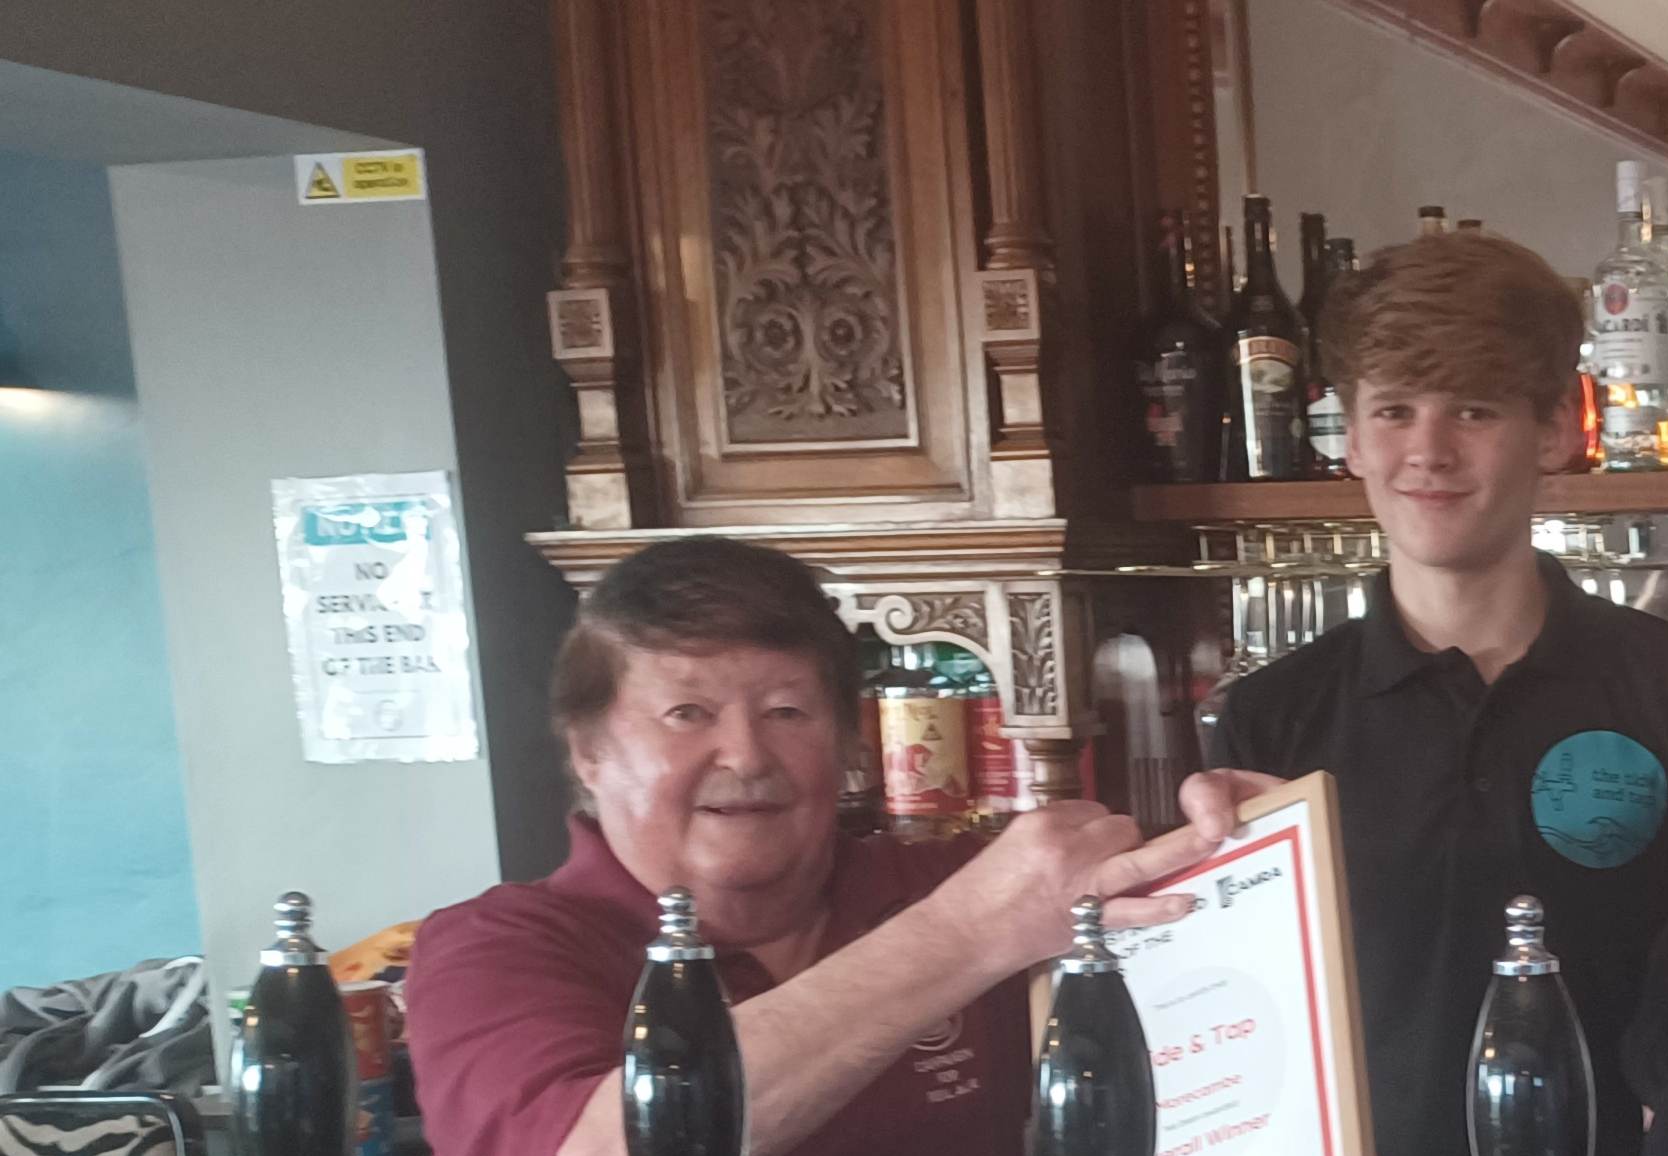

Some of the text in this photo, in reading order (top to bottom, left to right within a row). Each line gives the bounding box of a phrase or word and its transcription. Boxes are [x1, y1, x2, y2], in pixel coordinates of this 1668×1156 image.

[354, 561, 390, 580] NO
[383, 623, 427, 643] END
[1149, 1045, 1184, 1068] ide
[1208, 1018, 1256, 1045] Tap
[1206, 1112, 1271, 1146] Winner
